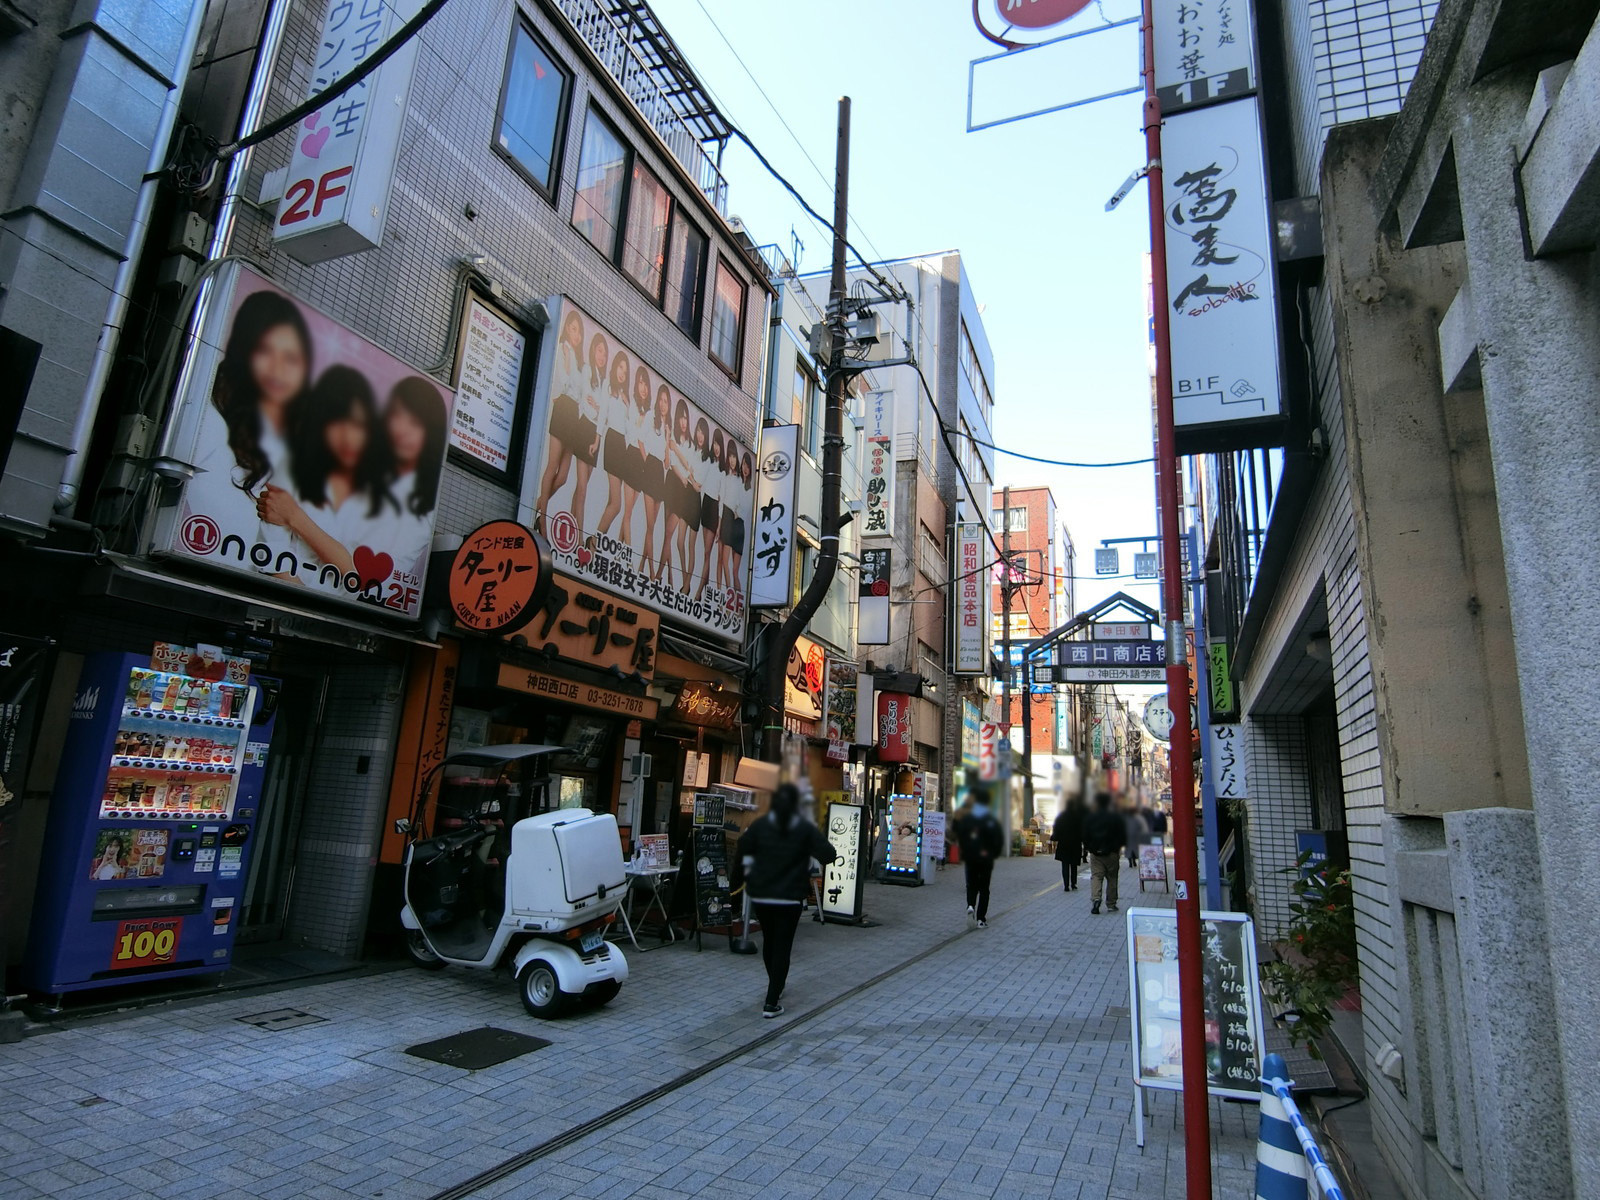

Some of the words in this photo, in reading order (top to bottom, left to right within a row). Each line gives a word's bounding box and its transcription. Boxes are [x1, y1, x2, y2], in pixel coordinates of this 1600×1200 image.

[1176, 73, 1229, 104] 1F
[279, 166, 353, 226] 2F
[472, 307, 522, 351] 料金システム
[1178, 376, 1220, 392] B1F
[474, 536, 525, 550] インド定食
[220, 534, 383, 603] non-non
[393, 569, 419, 586] 当ビル
[458, 550, 533, 587] ターリー
[385, 583, 420, 611] 2F
[475, 580, 498, 613] 屋
[594, 554, 742, 635] 現役女子大生だけのラウンジ
[705, 586, 727, 606] 当ビル
[963, 543, 977, 627] 昭和薬品本店
[726, 588, 745, 613] 2F
[457, 603, 481, 626] CURRY
[485, 617, 491, 627] &
[497, 600, 521, 625] NAAN
[1102, 626, 1141, 636] 神田駅
[155, 645, 190, 665] ホッと
[162, 661, 180, 672] する
[230, 670, 248, 682] もり
[1098, 669, 1161, 679] 神田外語学院
[1212, 655, 1226, 709] ひょうたん
[525, 672, 580, 700] 神田西口店
[587, 689, 644, 713] 03-3251-7878
[1214, 726, 1239, 797] ひょうたん
[117, 929, 175, 960] 100
[1219, 963, 1237, 979] 竹
[1221, 980, 1249, 993] 4100
[1228, 1022, 1248, 1036] 梅
[1226, 1037, 1254, 1052] 5100
[1245, 1057, 1256, 1069] 円
